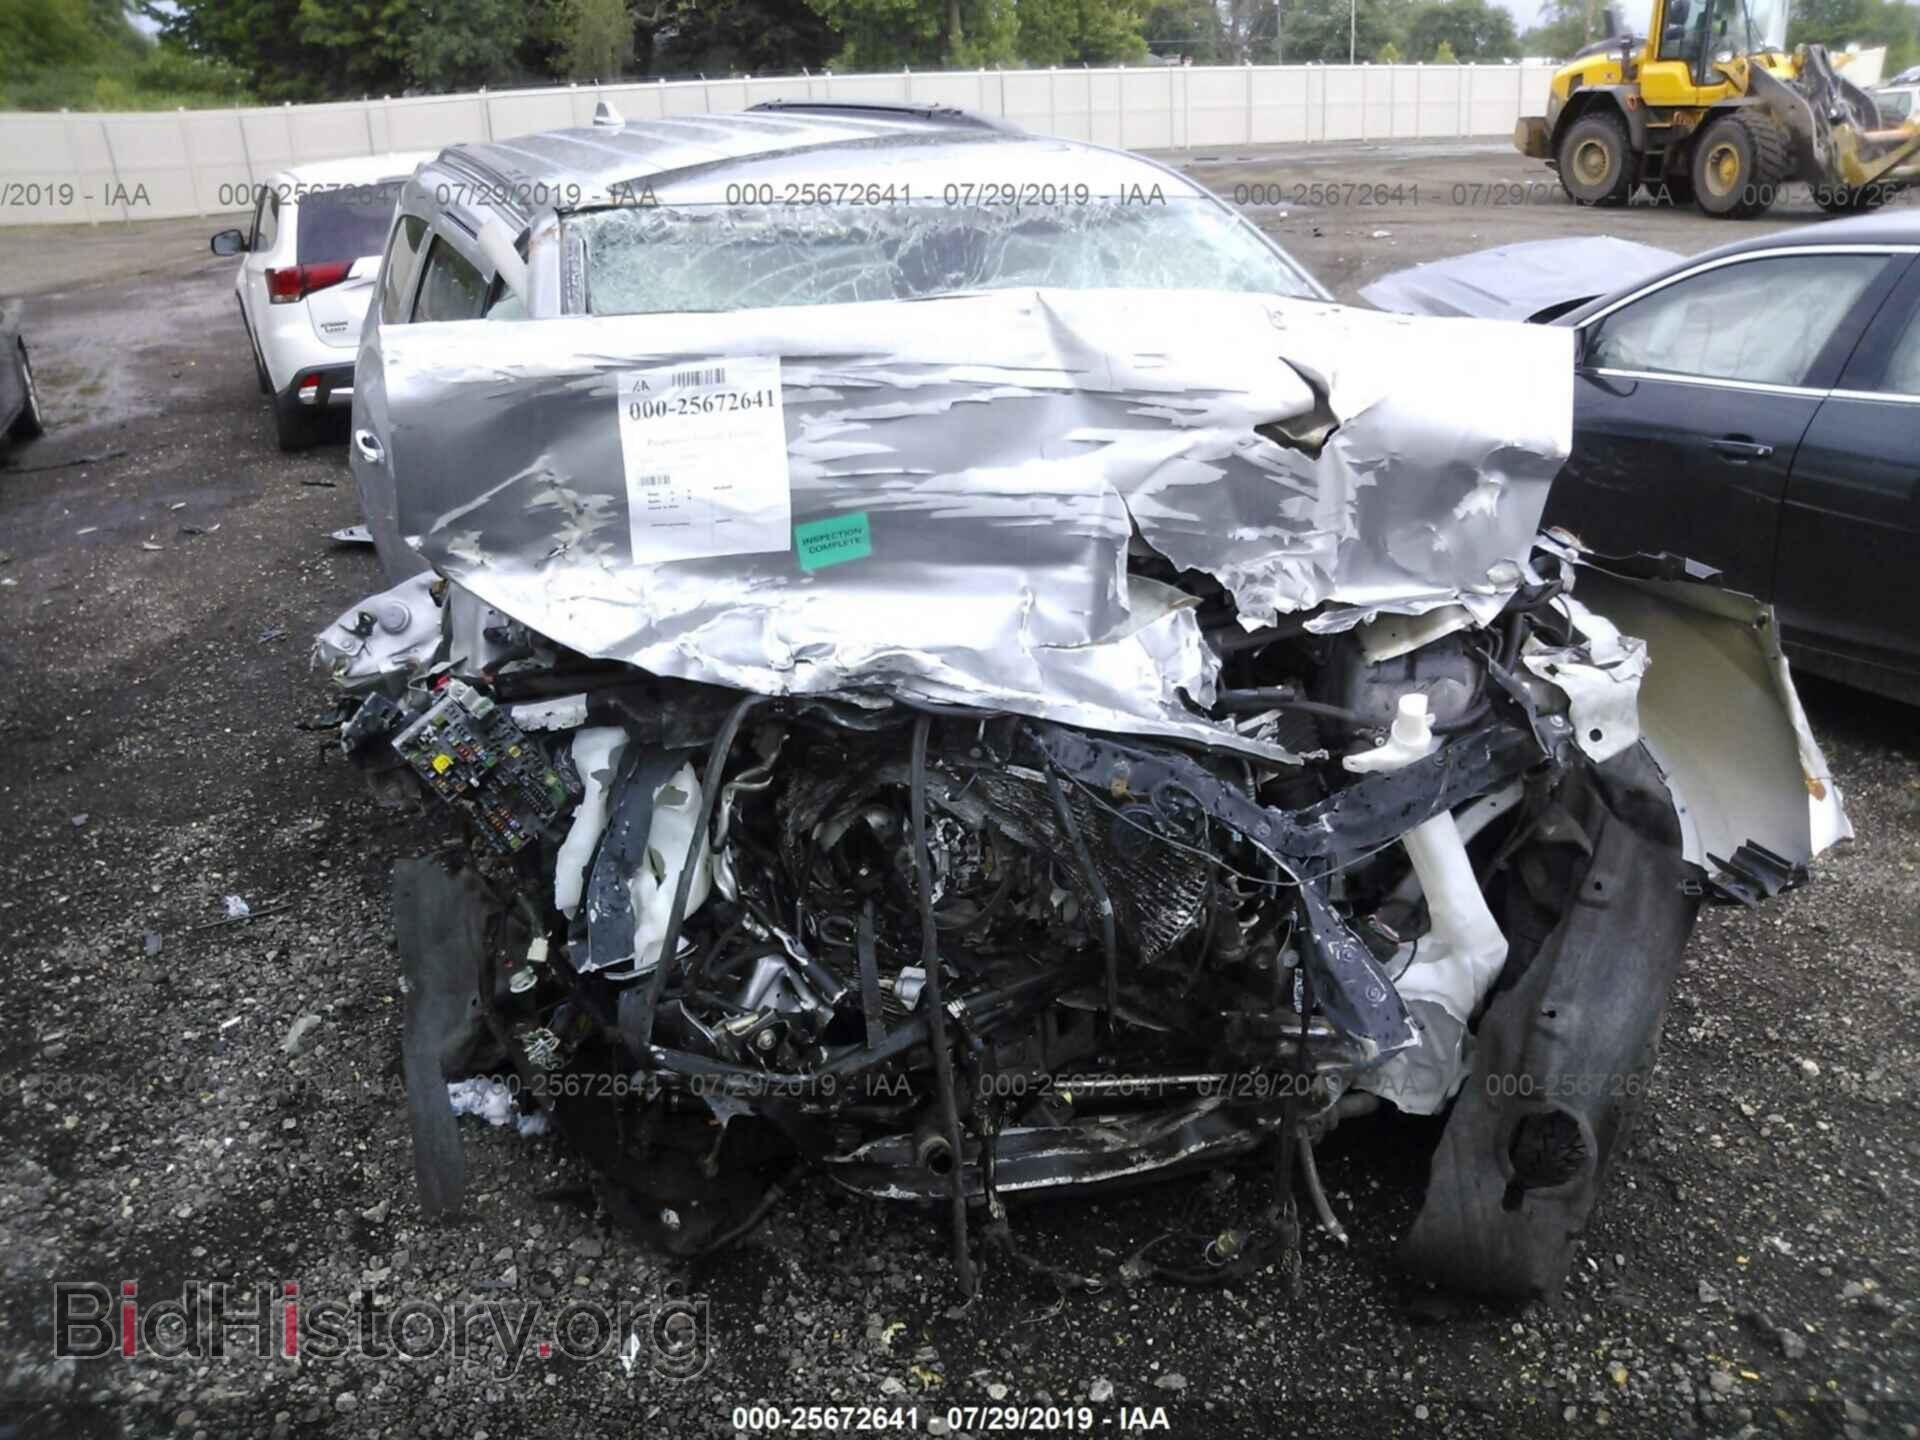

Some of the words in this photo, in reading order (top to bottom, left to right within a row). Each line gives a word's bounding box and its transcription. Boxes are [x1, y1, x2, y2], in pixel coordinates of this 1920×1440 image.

[629, 389, 775, 421] 000-25672641
[801, 527, 862, 547] INSPECTION
[808, 537, 860, 554] COMPLETE
